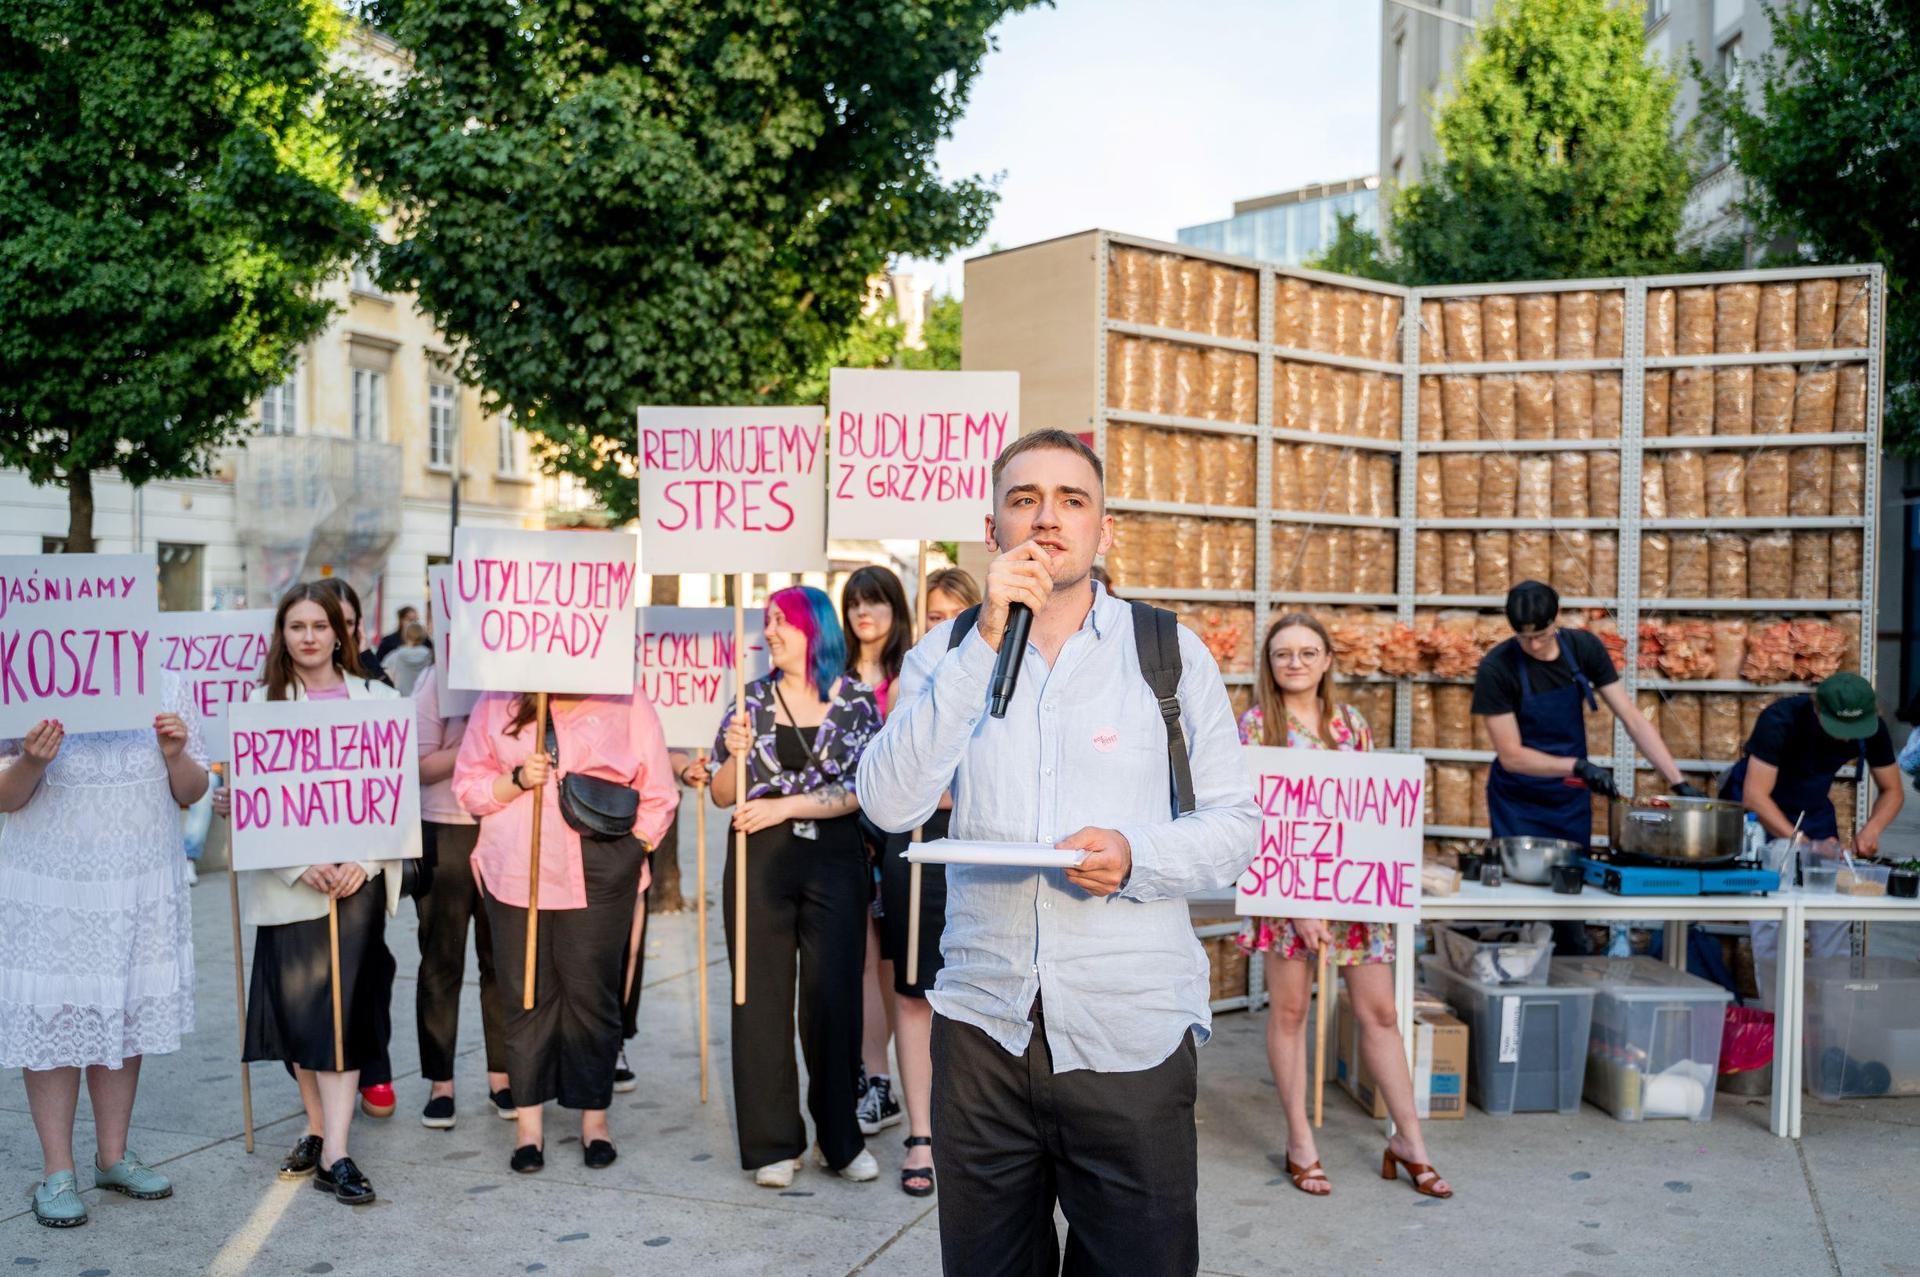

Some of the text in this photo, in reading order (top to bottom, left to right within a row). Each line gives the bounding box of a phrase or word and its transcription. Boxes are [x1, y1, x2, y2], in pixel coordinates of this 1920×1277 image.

[643, 424, 821, 476] REDUKUJEMY
[838, 410, 1008, 465] BUDUJEMY
[656, 479, 795, 533] STRES
[836, 463, 987, 502] Z GRZYBNI
[457, 558, 636, 612] UTYLIZUJEMY
[159, 633, 269, 672] ZYSZCZA
[481, 605, 609, 659] ODPADY
[0, 628, 149, 705] KOSZTY
[235, 773, 404, 832] DO NATURY
